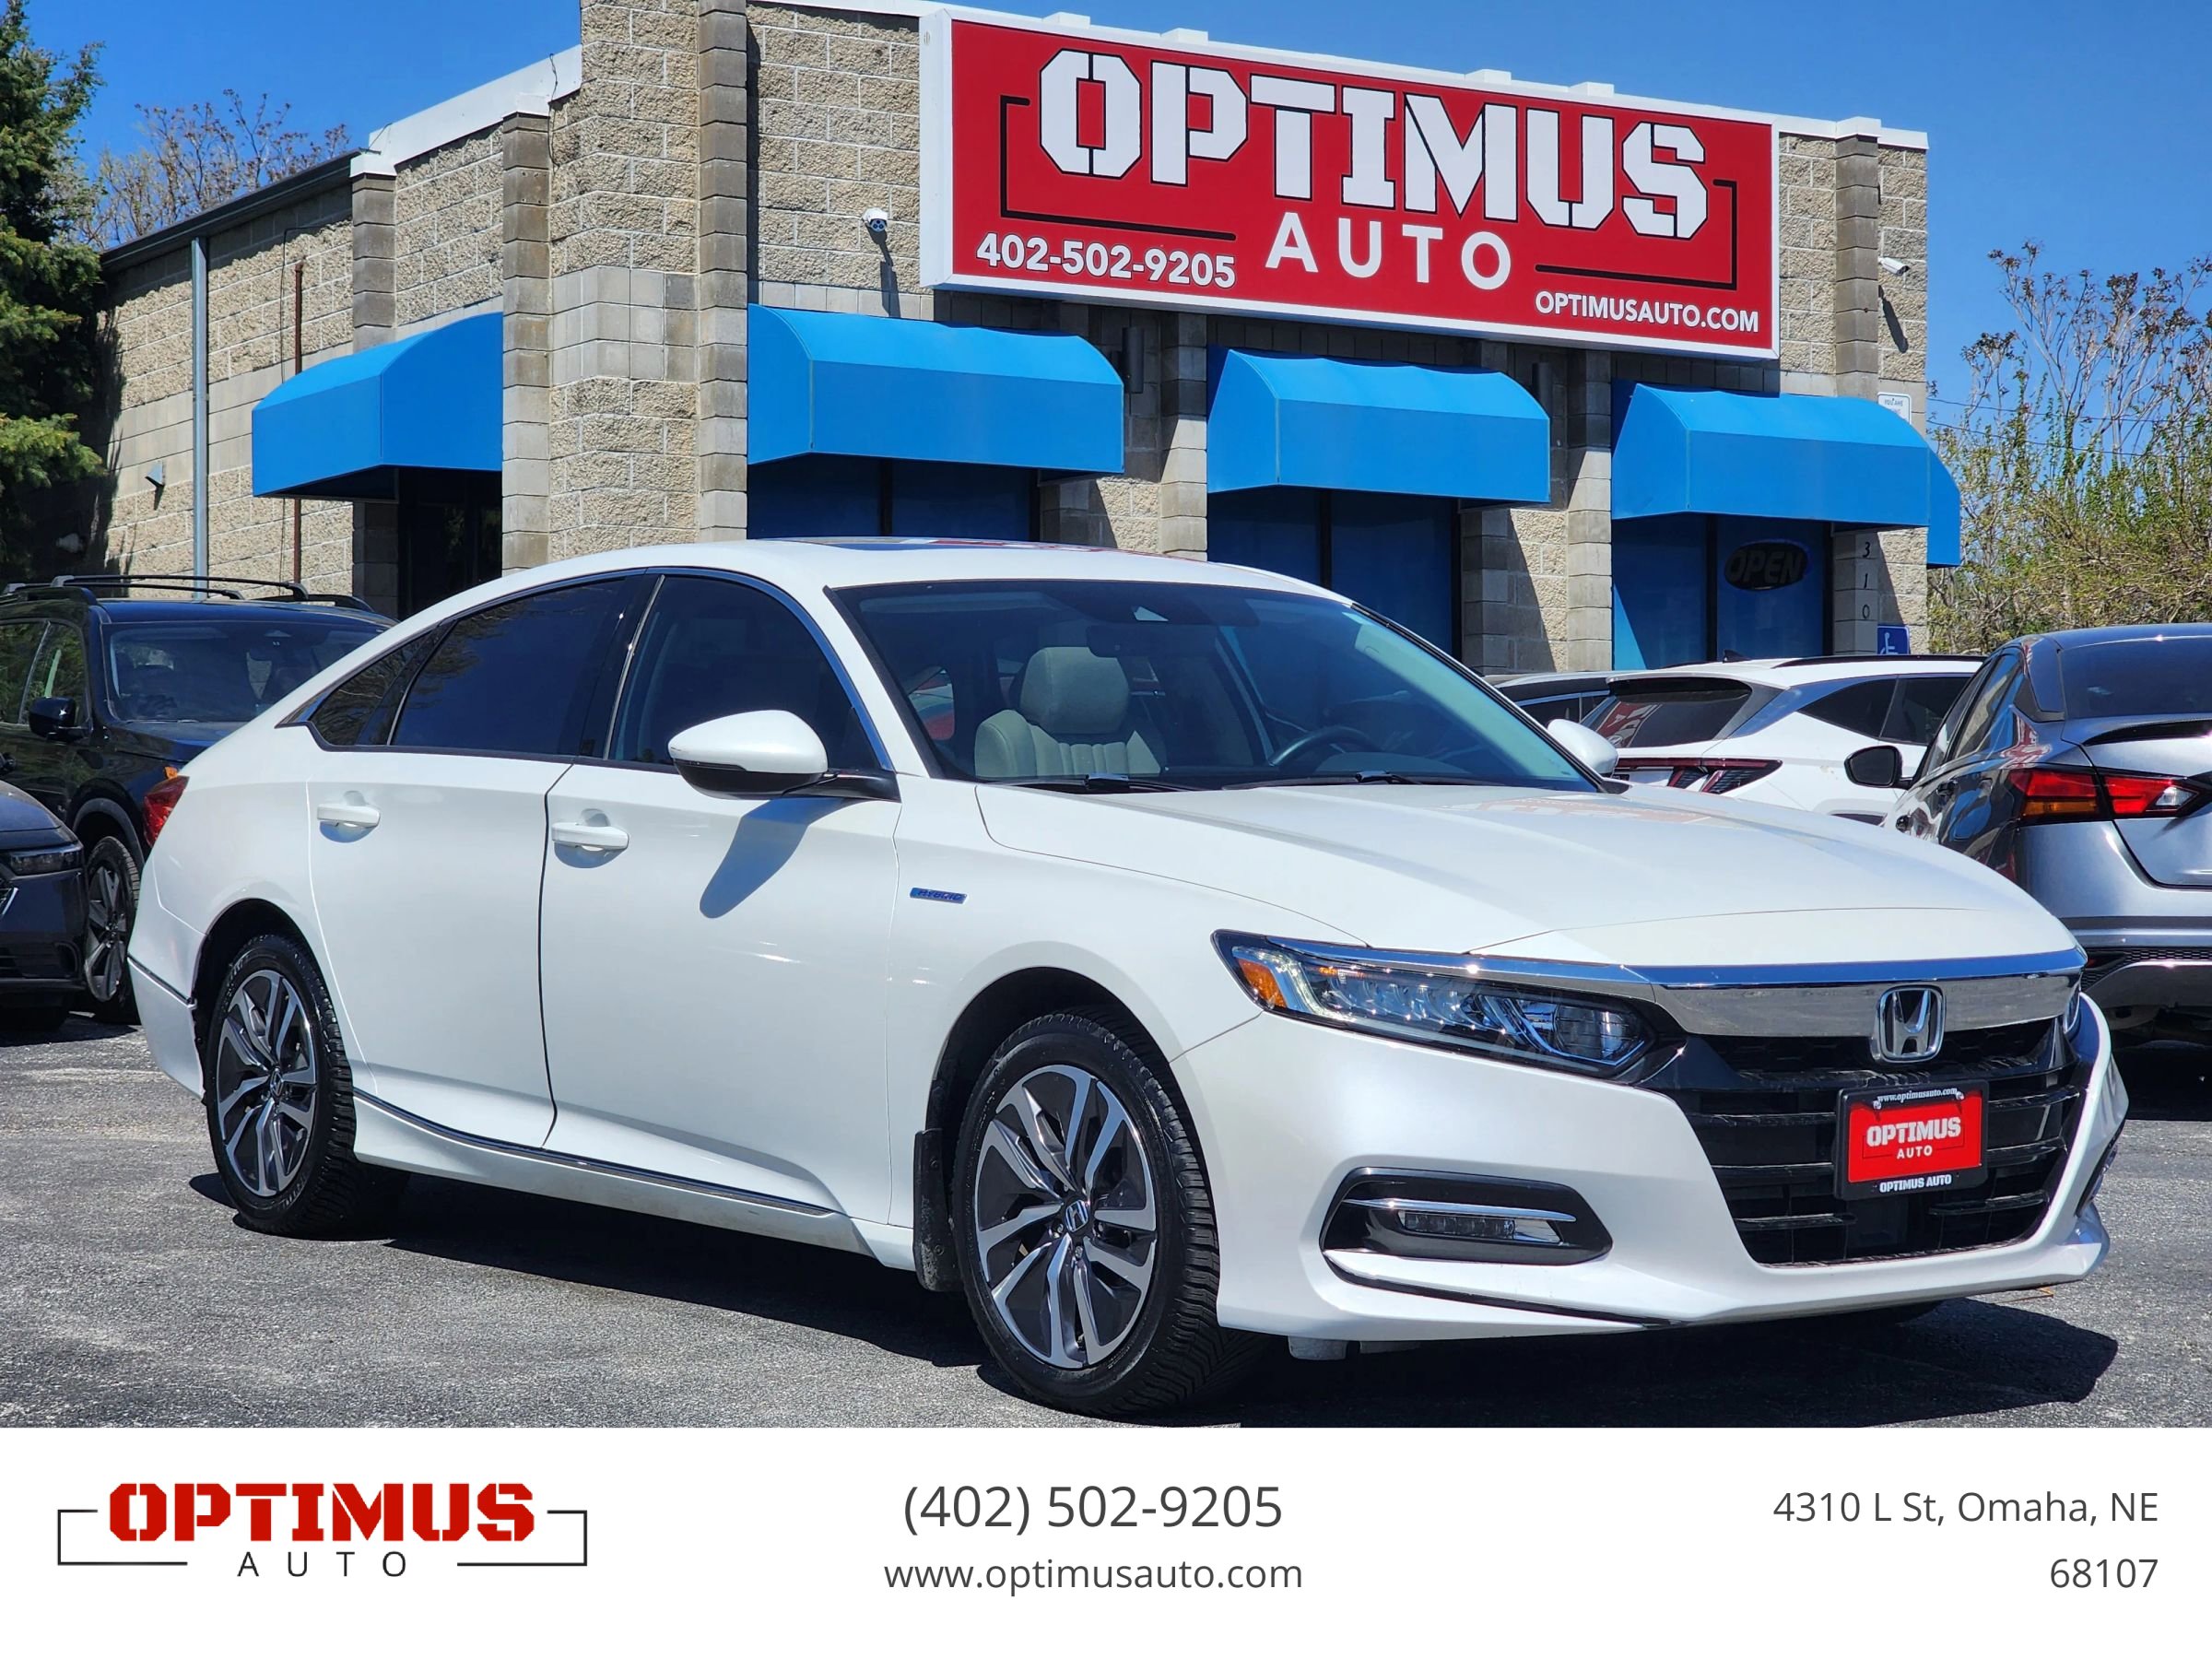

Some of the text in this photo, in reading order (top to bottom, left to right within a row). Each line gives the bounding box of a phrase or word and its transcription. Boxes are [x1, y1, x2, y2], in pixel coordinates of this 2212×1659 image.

[1040, 49, 1708, 240] OPTIMUS
[976, 232, 1236, 288] 402-502-9205
[1265, 211, 1512, 291] AUTO
[1535, 290, 1759, 333] OPTIMUSAUTO.COM
[1725, 550, 1805, 583] OPEN
[1877, 1087, 1959, 1104] www.optimusauto.com
[1866, 1116, 1961, 1147] OPTIMUS
[1896, 1145, 1934, 1159] AUTO
[1879, 1174, 1952, 1193] OPTIMUS AUTO
